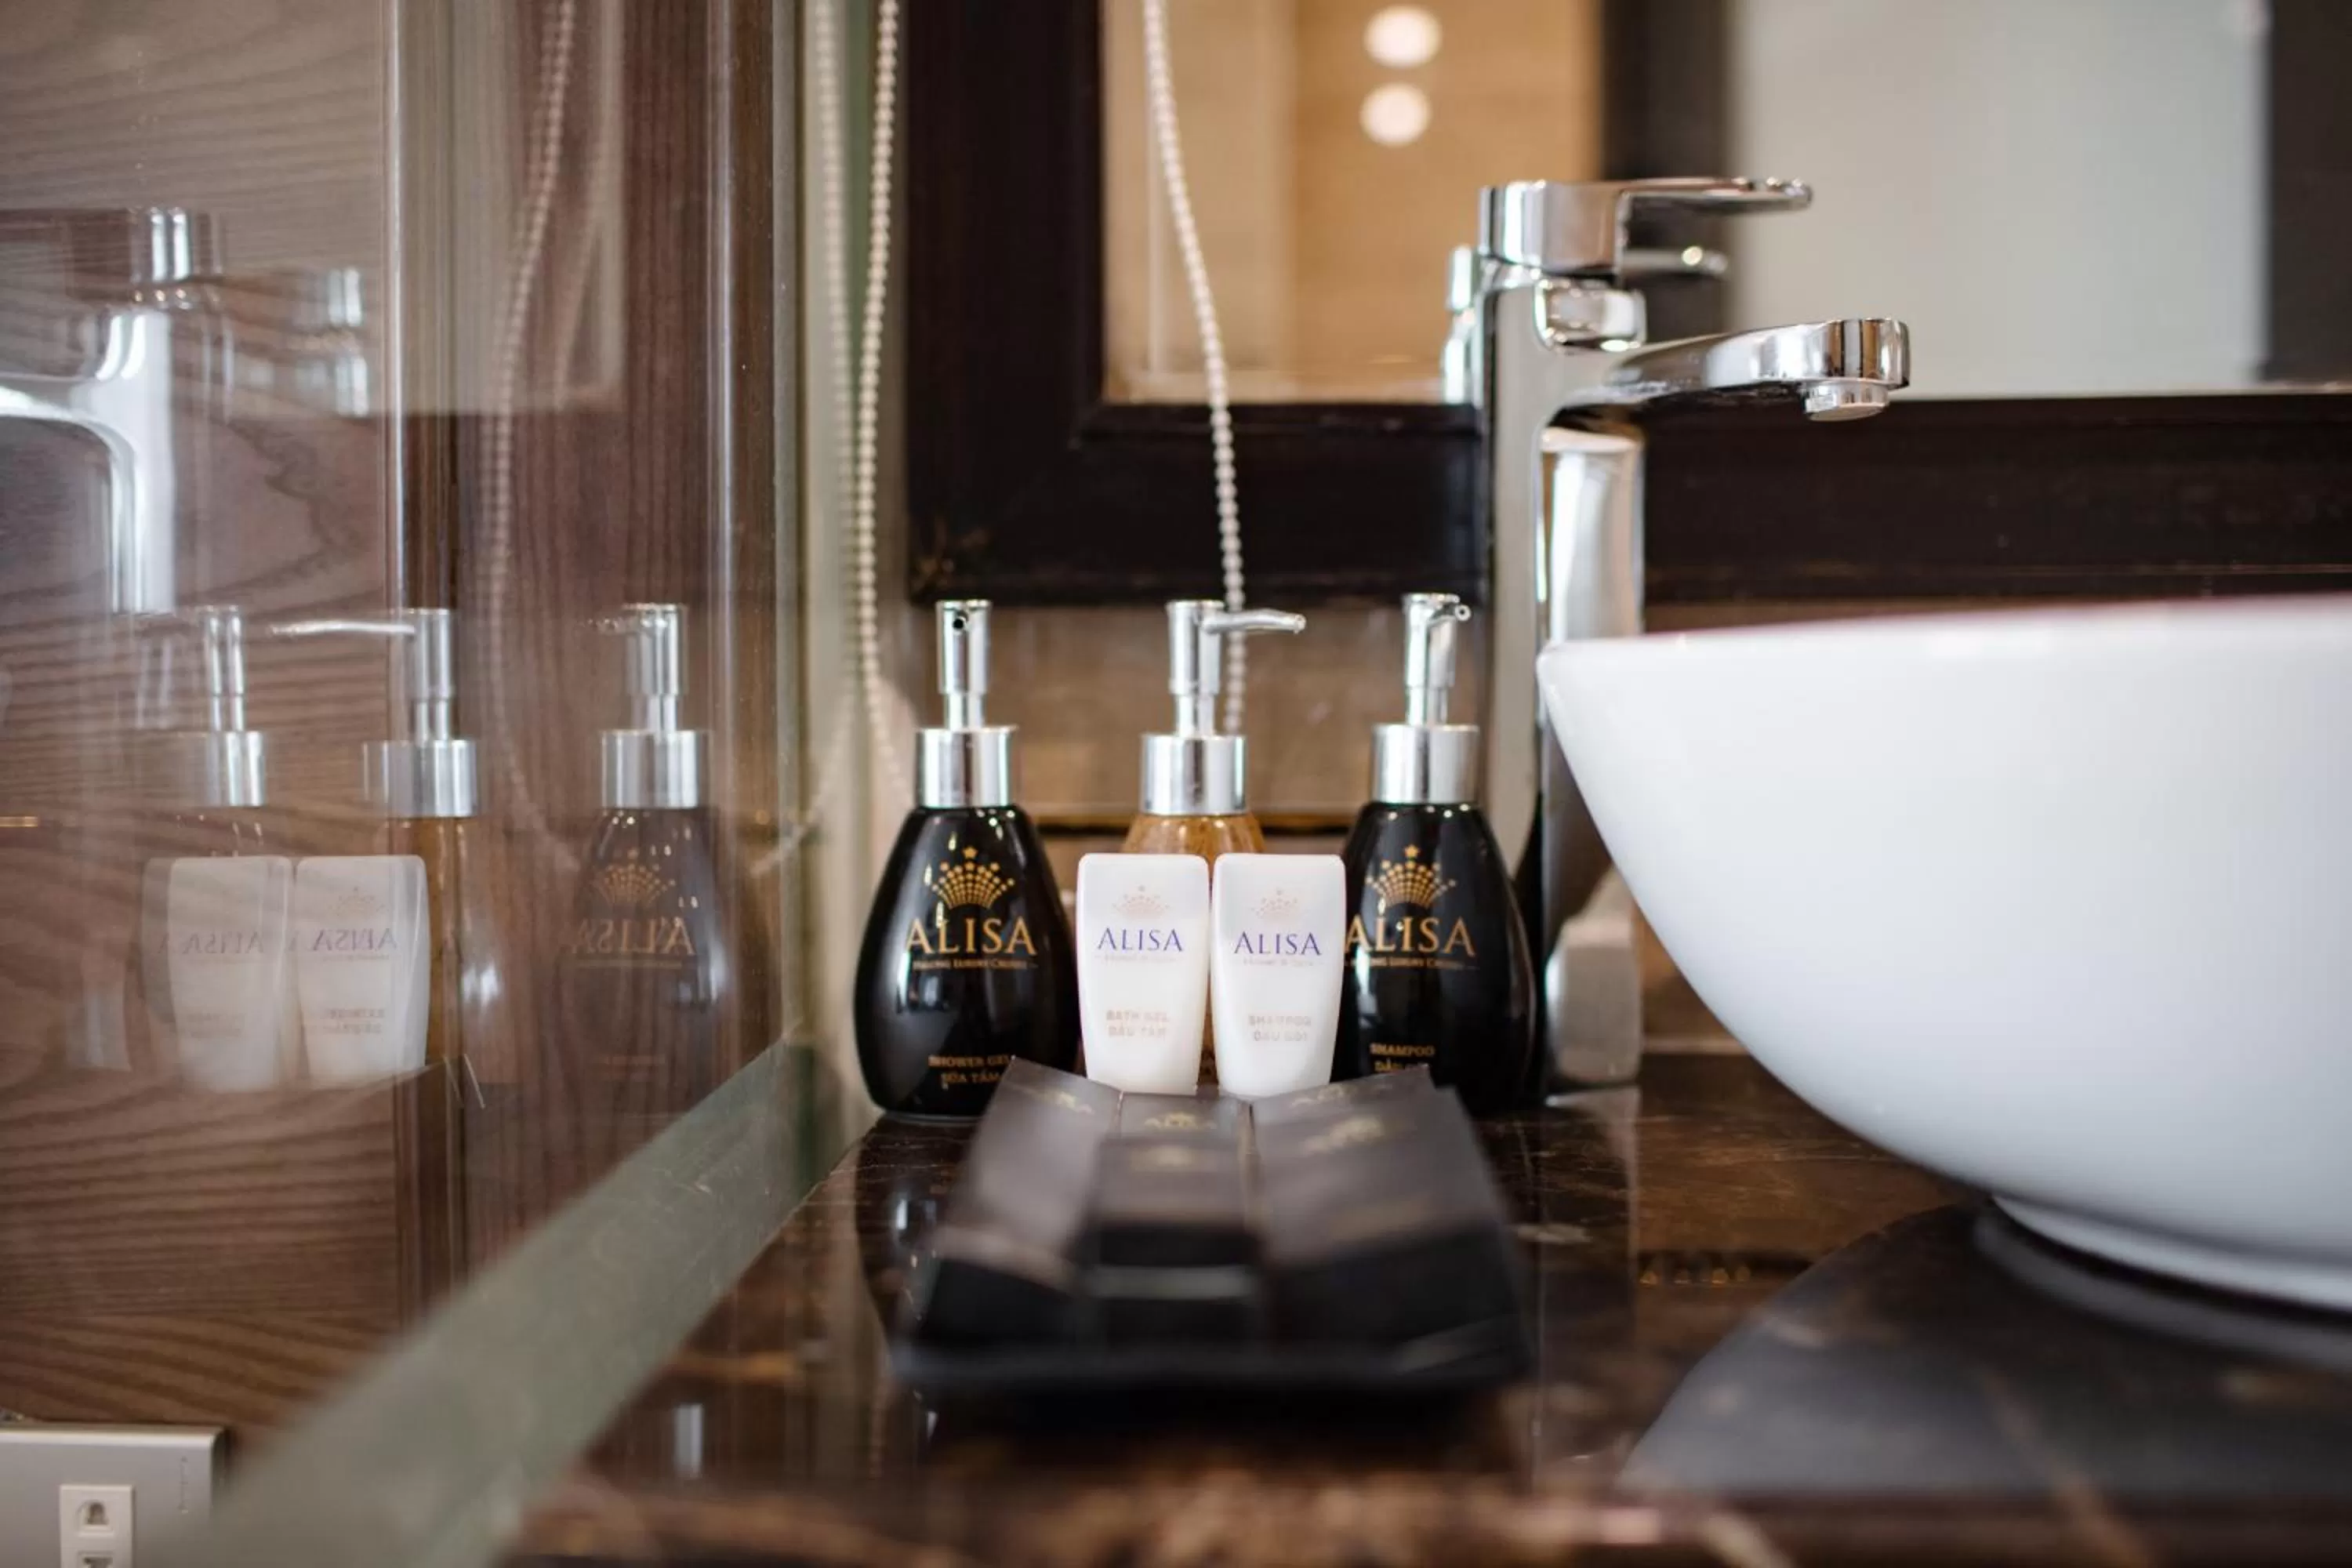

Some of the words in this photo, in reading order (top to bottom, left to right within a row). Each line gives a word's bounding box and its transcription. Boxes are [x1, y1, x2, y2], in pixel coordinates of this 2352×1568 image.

[905, 916, 1038, 956] ALISA
[1098, 927, 1185, 953] ALISA
[1234, 931, 1323, 956] ALISA
[1344, 914, 1476, 957] ALISA
[928, 1054, 985, 1068] SHOWER
[1369, 1043, 1436, 1057] SHAMPOO
